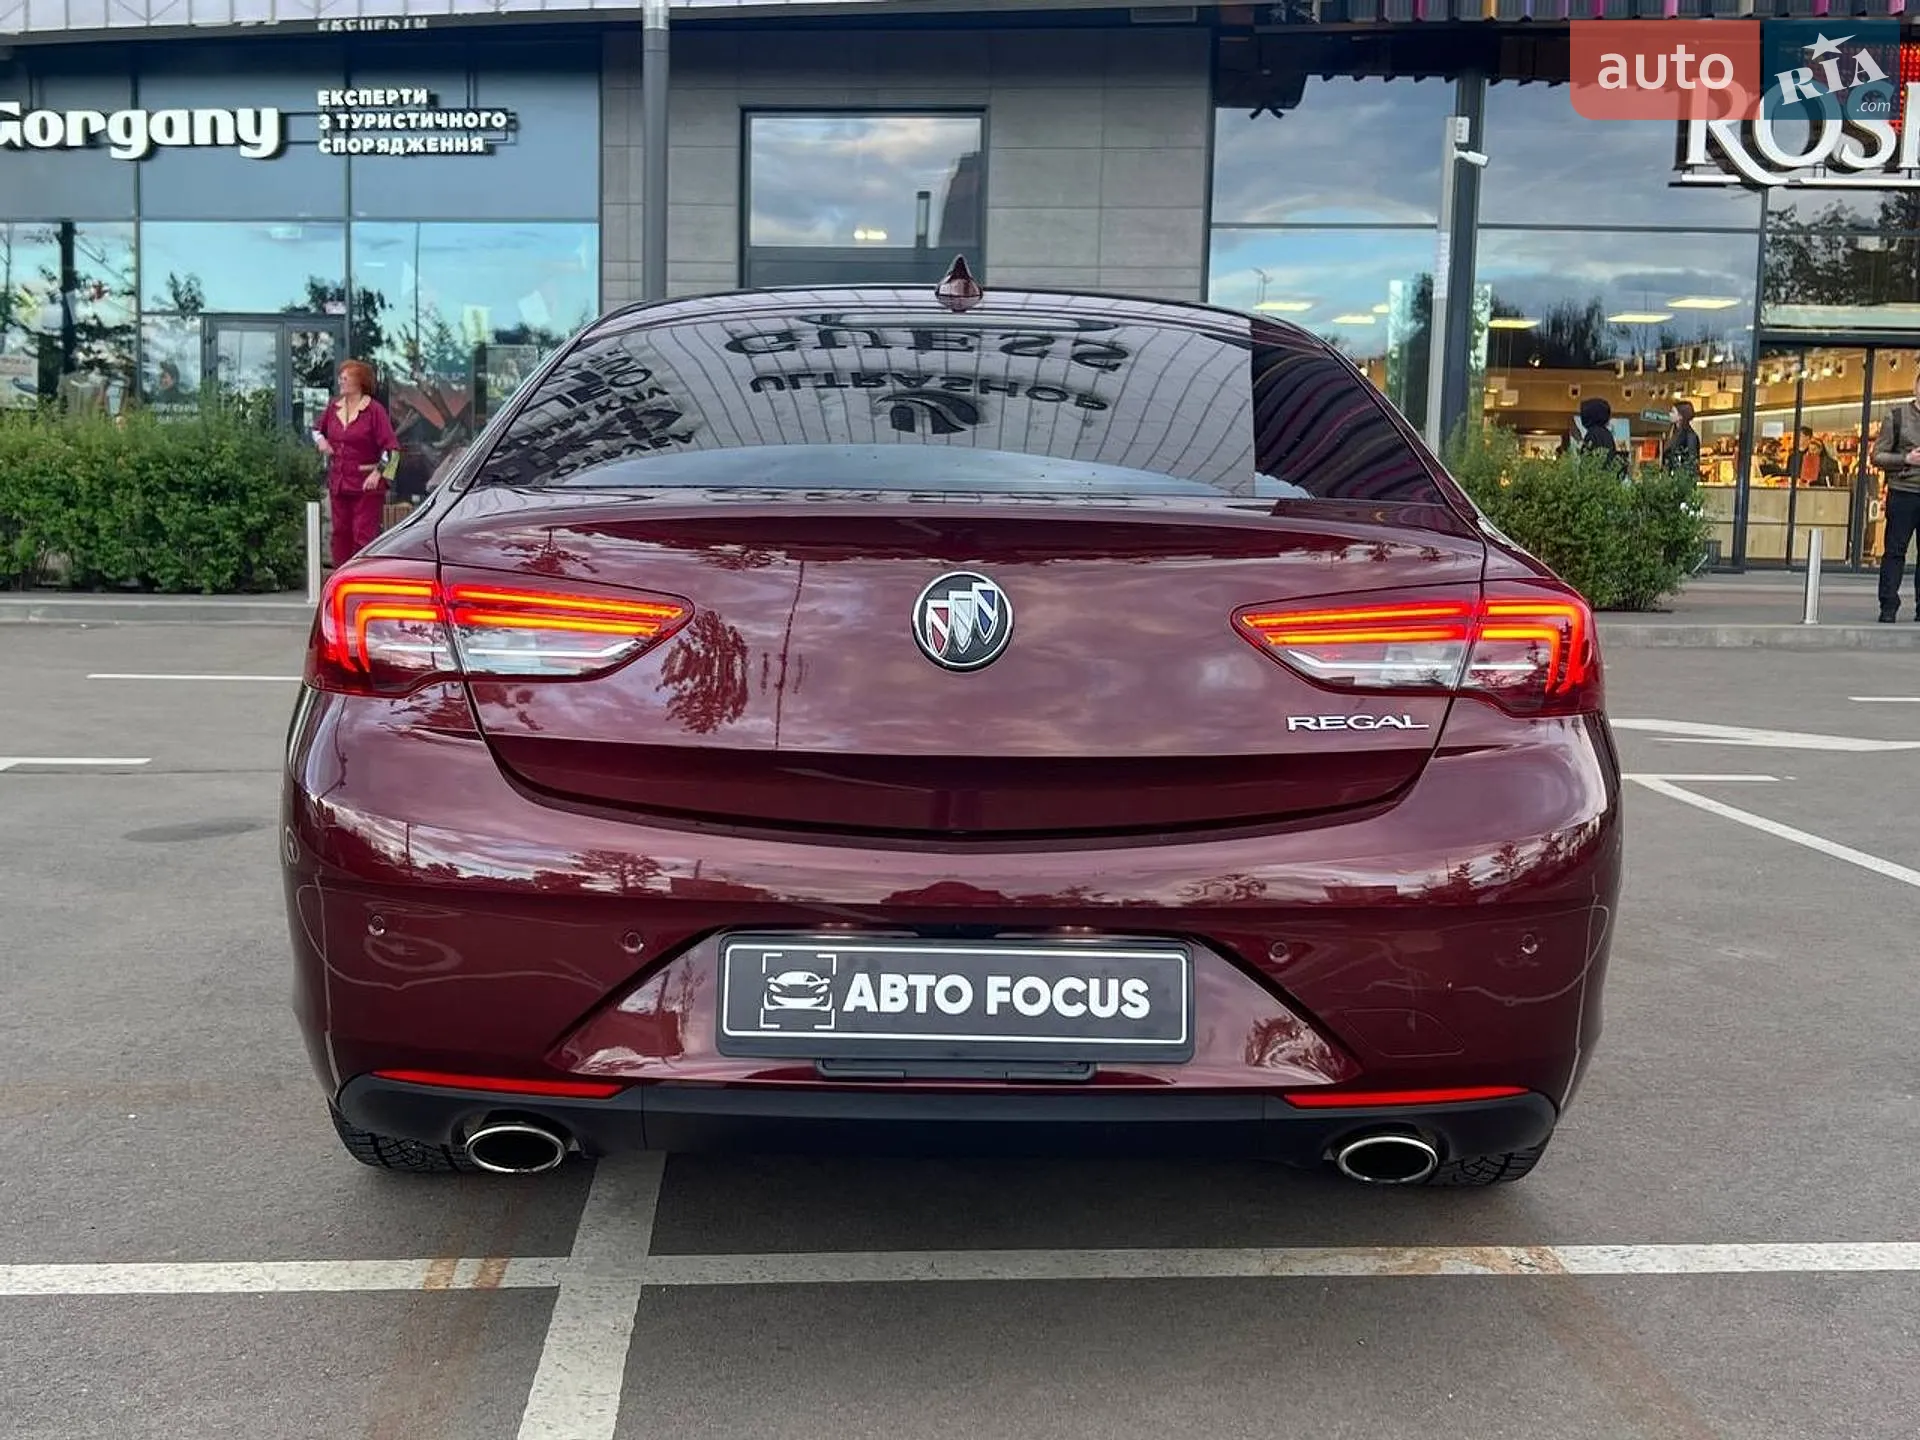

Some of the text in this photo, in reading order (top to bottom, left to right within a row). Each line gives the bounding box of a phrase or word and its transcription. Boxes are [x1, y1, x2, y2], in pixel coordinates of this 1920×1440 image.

[317, 88, 429, 107] ЕКСПЕРТИ
[336, 111, 507, 130] ТУРИСТИЧНОГО
[1686, 77, 1920, 185] ROS
[318, 137, 486, 156] СПОРЯДЖЕННЯ
[1287, 714, 1430, 731] REGAL
[842, 973, 1151, 1019] АВТО FOCUS
